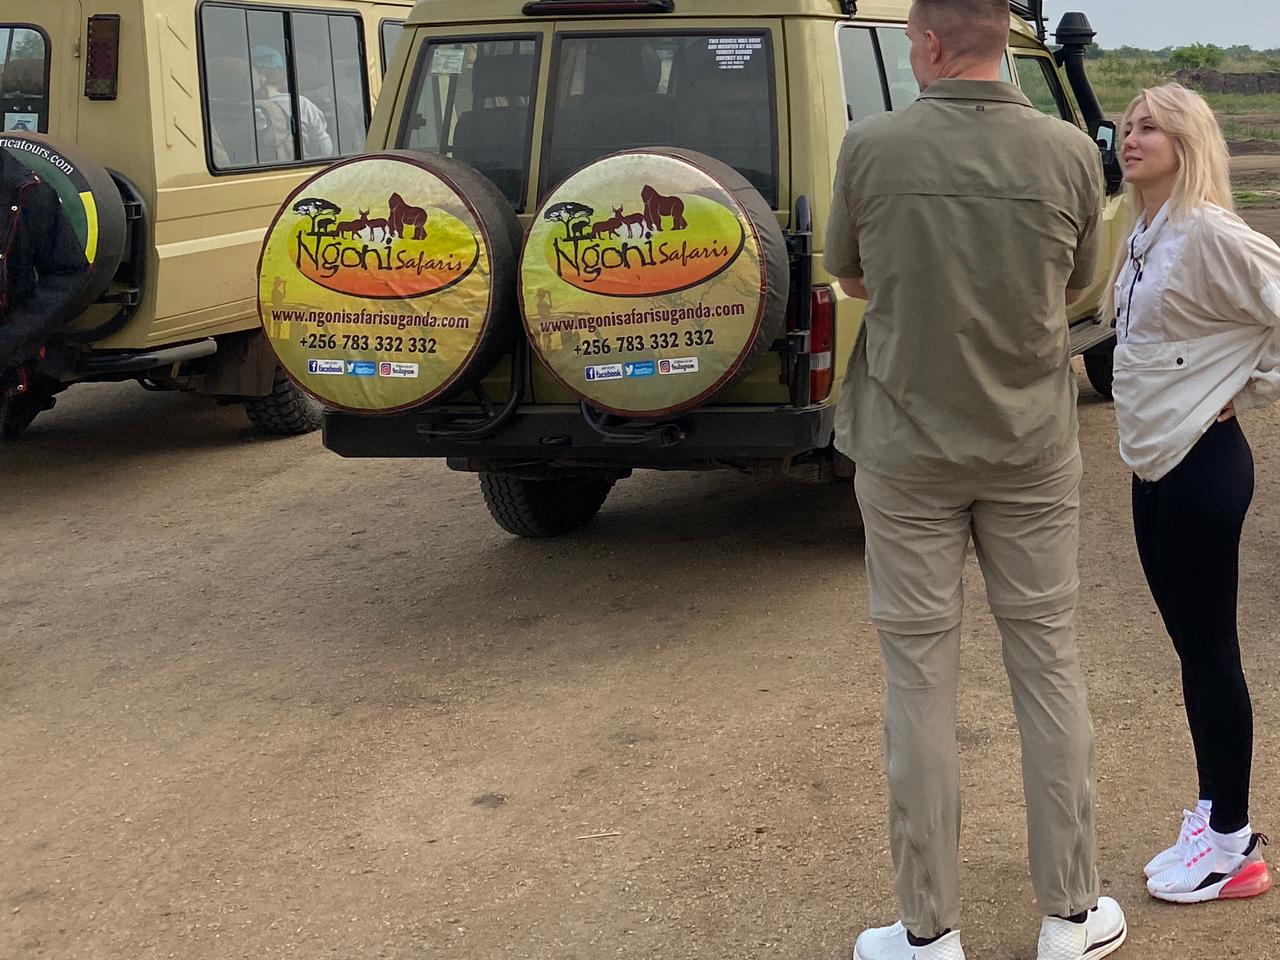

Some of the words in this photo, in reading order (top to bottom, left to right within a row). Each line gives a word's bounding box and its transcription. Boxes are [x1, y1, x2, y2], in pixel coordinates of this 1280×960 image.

[297, 230, 393, 278] Ngoni
[395, 249, 463, 276] Safaris
[553, 232, 657, 283] Ngoni
[658, 240, 729, 267] Safaris
[271, 308, 470, 330] www.ngonisafarisuganda.com
[540, 302, 746, 333] www.ngonisafarisuganda.com
[300, 334, 337, 350] +256
[342, 334, 369, 351] 783
[374, 336, 403, 353] 332
[408, 337, 437, 354] 332
[574, 338, 611, 356] +256
[616, 335, 645, 353] 783
[650, 332, 680, 350] 332
[684, 329, 715, 347] 332
